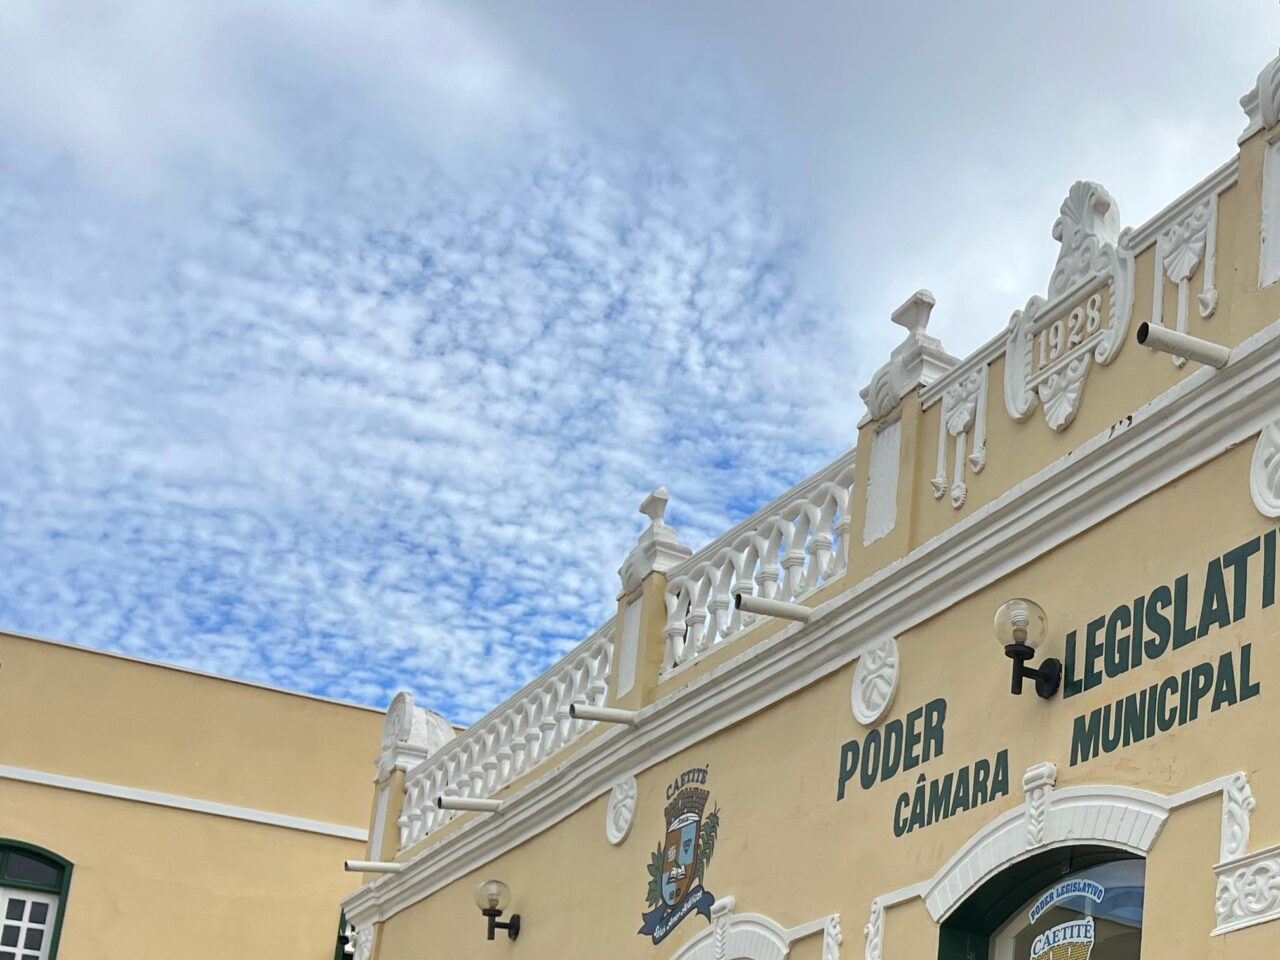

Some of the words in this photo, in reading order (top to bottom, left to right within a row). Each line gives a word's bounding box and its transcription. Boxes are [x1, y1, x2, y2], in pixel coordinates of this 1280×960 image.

[1038, 293, 1102, 369] 1928
[837, 698, 947, 801] PODER
[894, 749, 1009, 837] CÂMARA
[1070, 643, 1261, 766] MUNICIPAL
[666, 763, 709, 800] CAETITÉ
[1030, 892, 1055, 920] PODER
[1056, 882, 1103, 900] LEGISLATIVO
[1033, 920, 1093, 955] CAETITÉ
